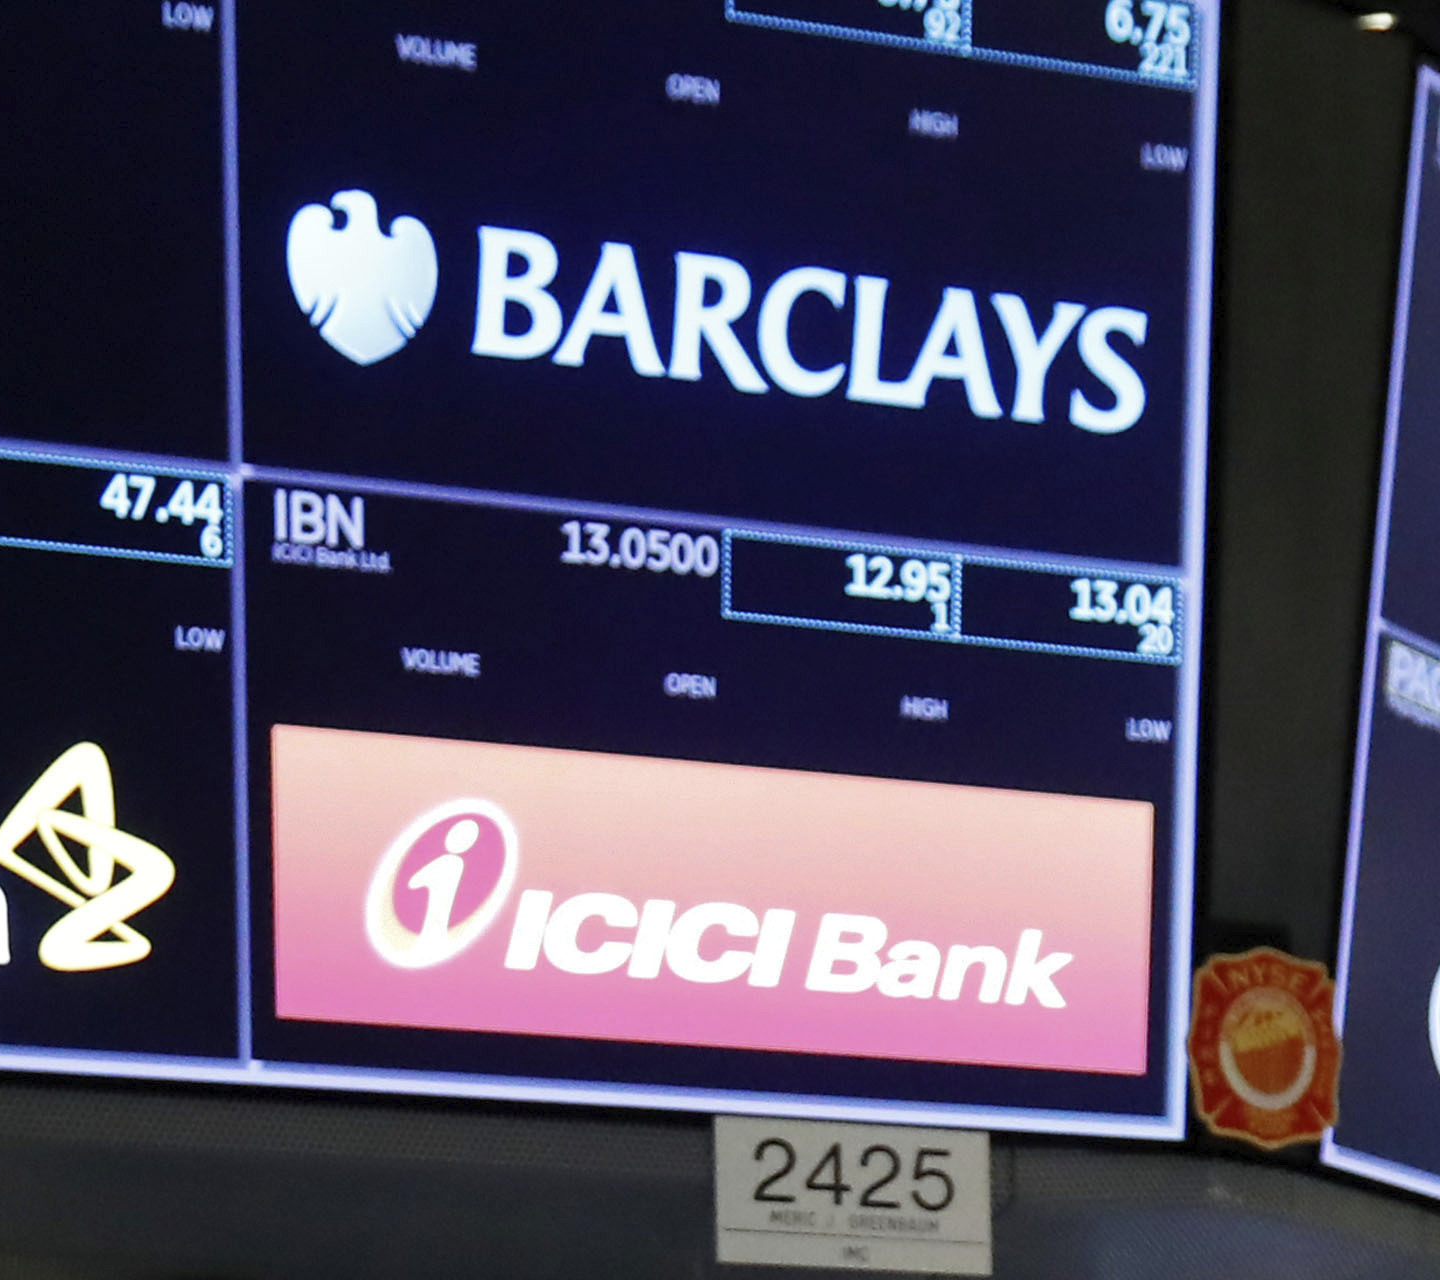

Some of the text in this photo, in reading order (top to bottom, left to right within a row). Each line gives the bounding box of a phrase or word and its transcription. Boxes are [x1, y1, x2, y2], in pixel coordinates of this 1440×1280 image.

[470, 224, 1149, 435] BARCLAYS
[99, 472, 224, 525] 47.44
[272, 486, 366, 550] IBN
[199, 525, 224, 558] 6
[560, 519, 720, 578] 13.0500
[843, 552, 953, 604] 12.95
[1068, 576, 1176, 628] 13.04
[174, 624, 226, 653] LOW
[400, 646, 482, 678] VOLUME
[664, 670, 718, 700] OPEN
[900, 695, 949, 723] HIGH
[1125, 716, 1173, 744] LOW
[504, 888, 797, 989] ICICI
[805, 911, 1074, 1010] Bank
[752, 1136, 956, 1212] 2425
